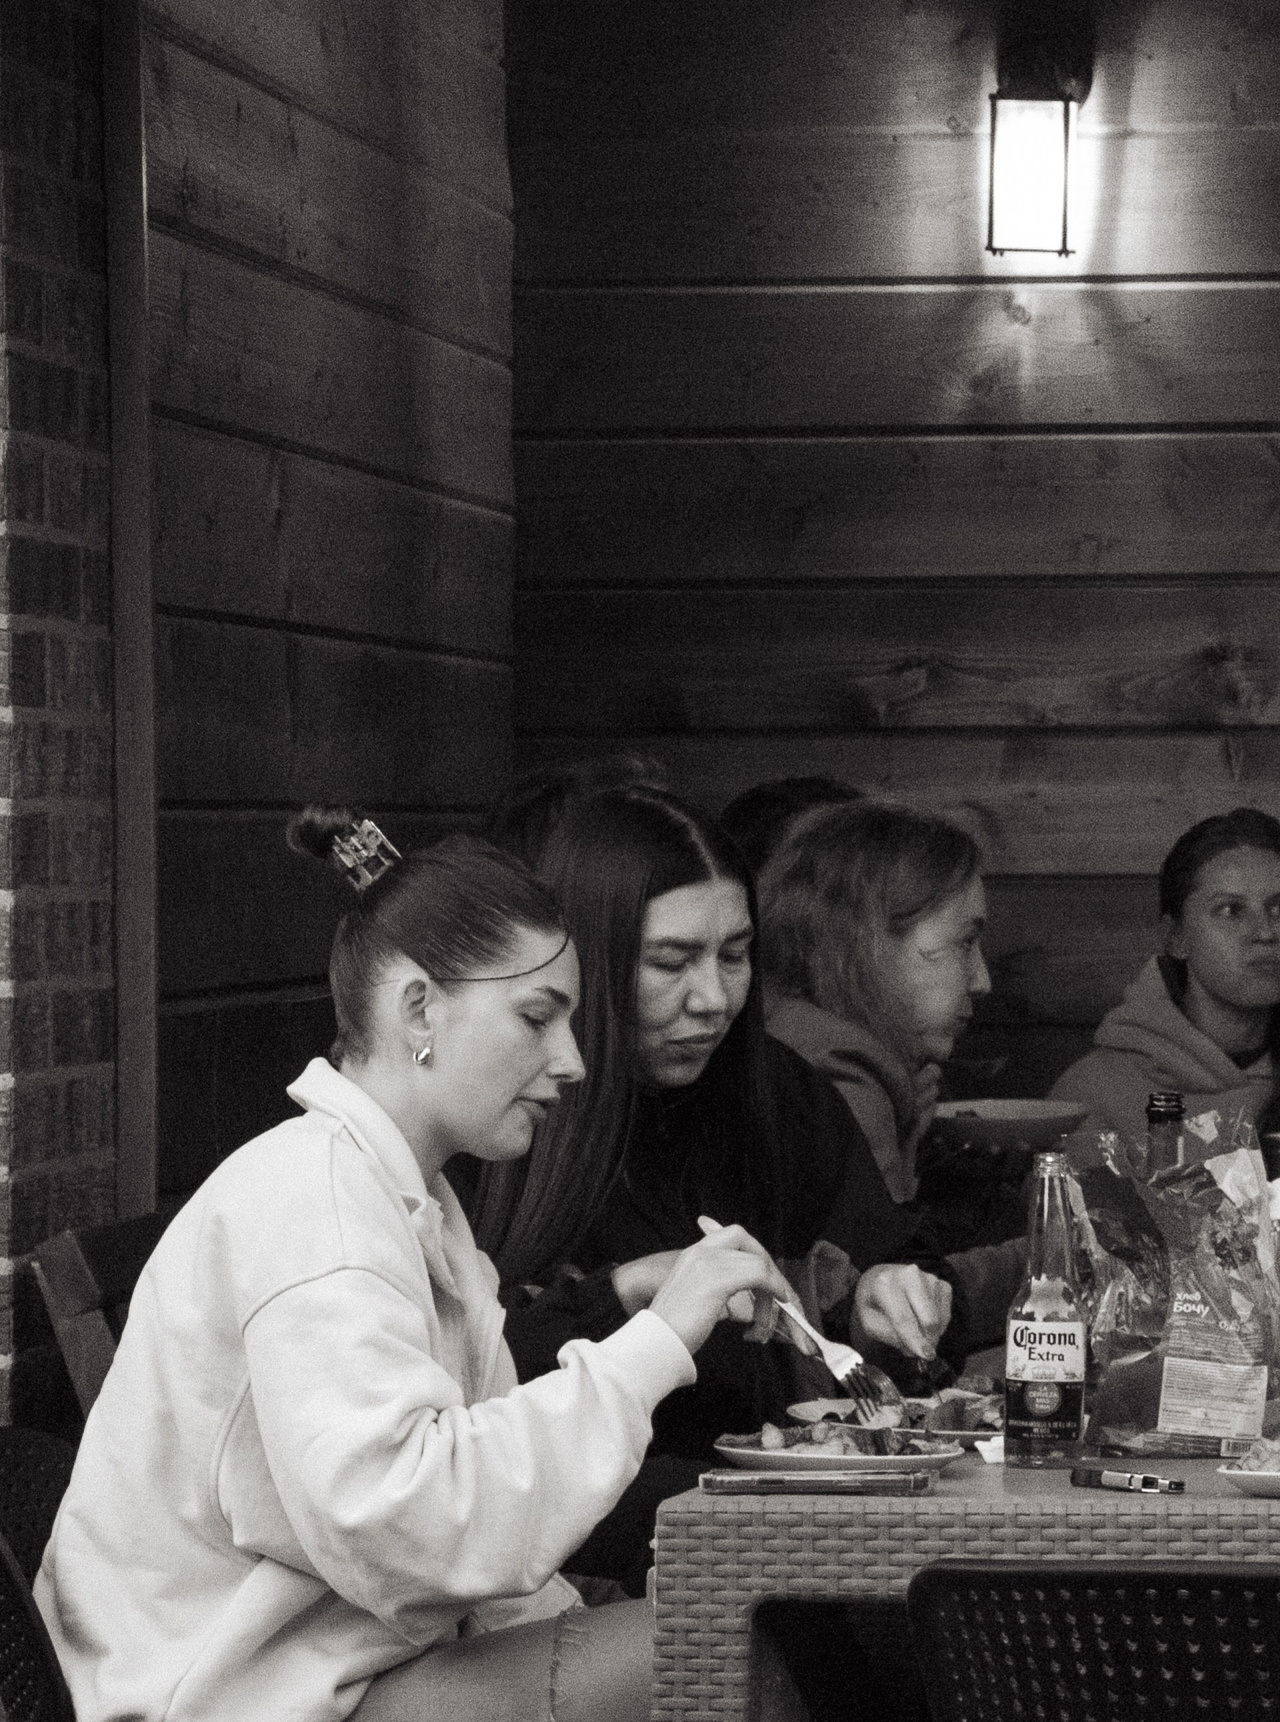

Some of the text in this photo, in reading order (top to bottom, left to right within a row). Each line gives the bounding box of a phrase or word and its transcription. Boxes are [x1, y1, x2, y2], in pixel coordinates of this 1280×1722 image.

[1173, 1301, 1210, 1318] Бочу
[1013, 1326, 1077, 1350] Corona
[1028, 1347, 1065, 1361] Extra
